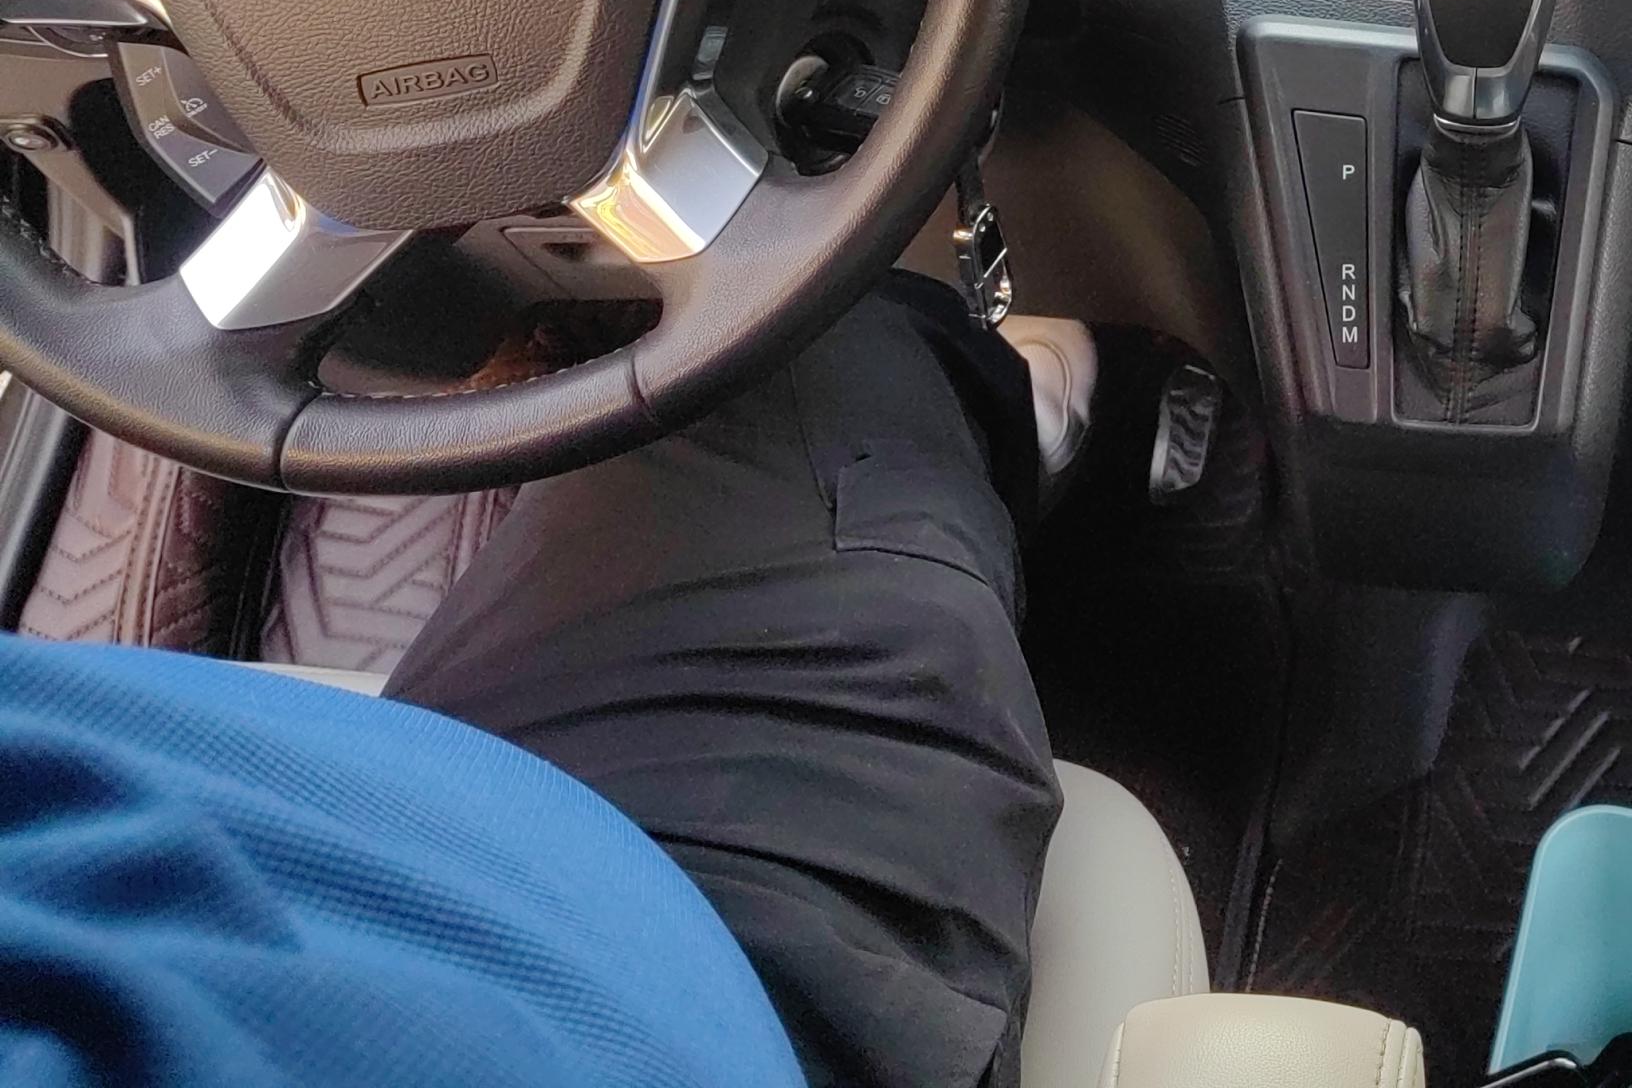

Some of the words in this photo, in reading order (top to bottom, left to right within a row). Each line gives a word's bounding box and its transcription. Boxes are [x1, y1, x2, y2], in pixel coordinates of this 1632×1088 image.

[136, 66, 161, 86] SET+
[371, 63, 490, 99] AIRBAG
[154, 123, 175, 140] RES
[1342, 164, 1356, 181] P
[1342, 264, 1356, 280] R
[1342, 284, 1356, 300] N
[1342, 305, 1356, 322] D
[1342, 326, 1358, 343] M
